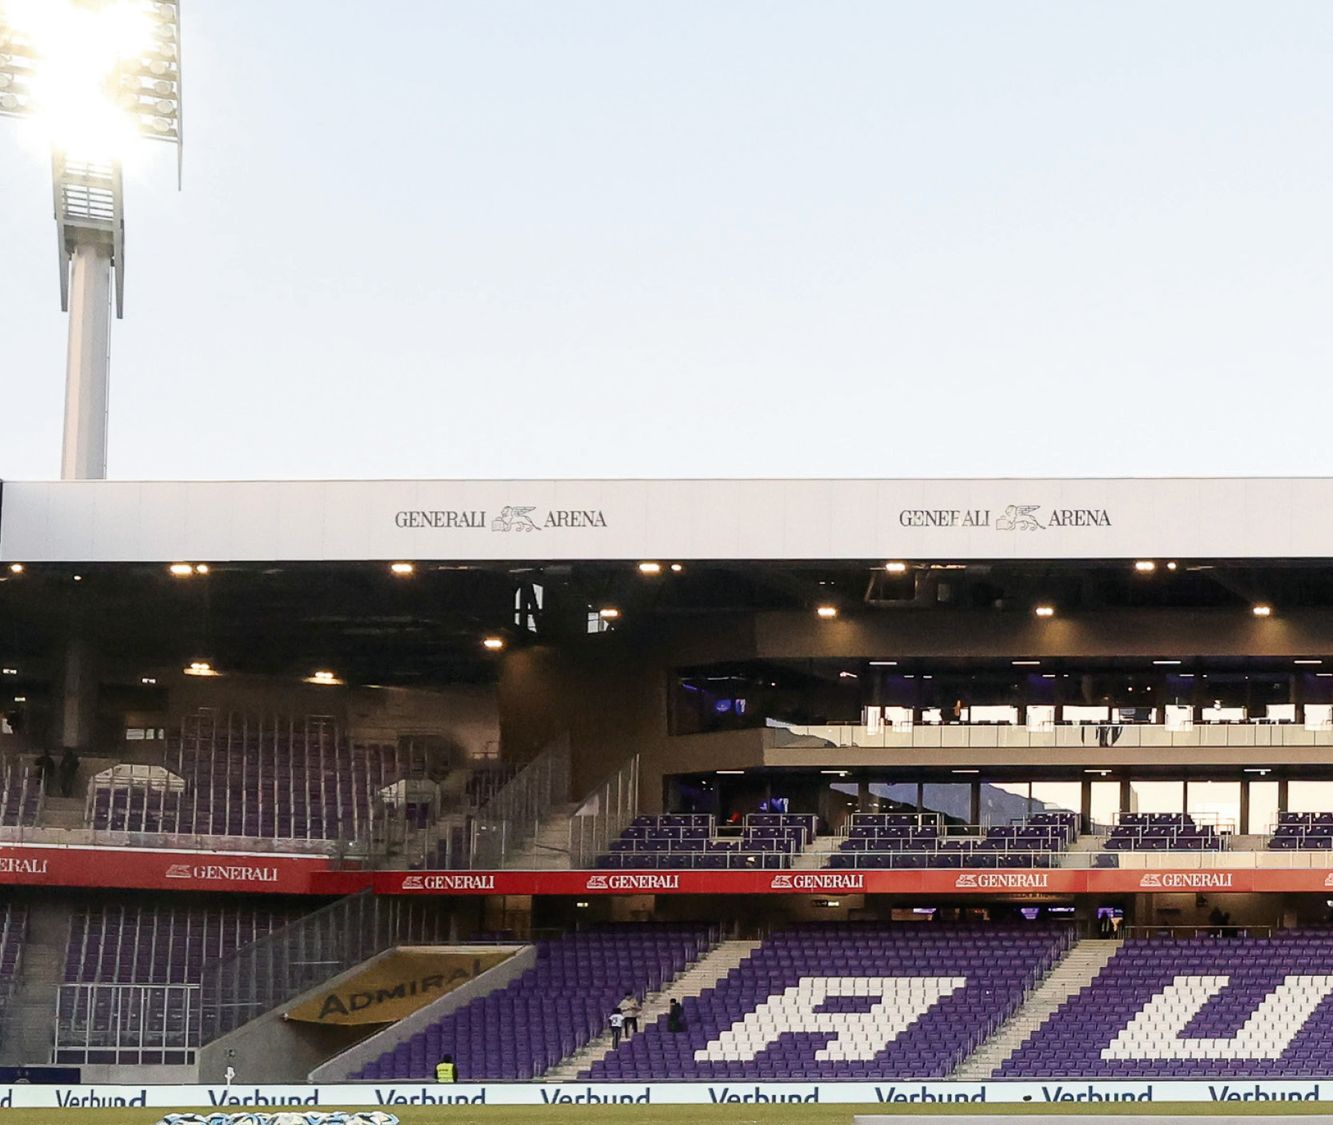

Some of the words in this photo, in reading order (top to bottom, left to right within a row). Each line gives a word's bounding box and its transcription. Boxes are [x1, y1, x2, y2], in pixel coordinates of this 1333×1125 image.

[395, 511, 486, 528] GENERALI
[544, 510, 607, 528] ARENA
[1049, 509, 1112, 527] ARENA
[0, 857, 48, 873] ERALI
[193, 866, 278, 882] GENERALI
[424, 875, 495, 889] GENERALI
[608, 875, 680, 889] GENERALI
[793, 874, 864, 888] GENERALI
[977, 874, 1048, 887] GENERALI
[1161, 873, 1232, 887] GENERALI
[56, 1089, 146, 1107] Verbund
[208, 1089, 318, 1106] Verbund
[375, 1088, 485, 1105] Verbund
[541, 1087, 650, 1104] Verbund
[708, 1087, 818, 1103] Verbund
[875, 1086, 985, 1102] Verbund
[1042, 1085, 1152, 1101] Verbund
[1209, 1085, 1319, 1100] Verbund
